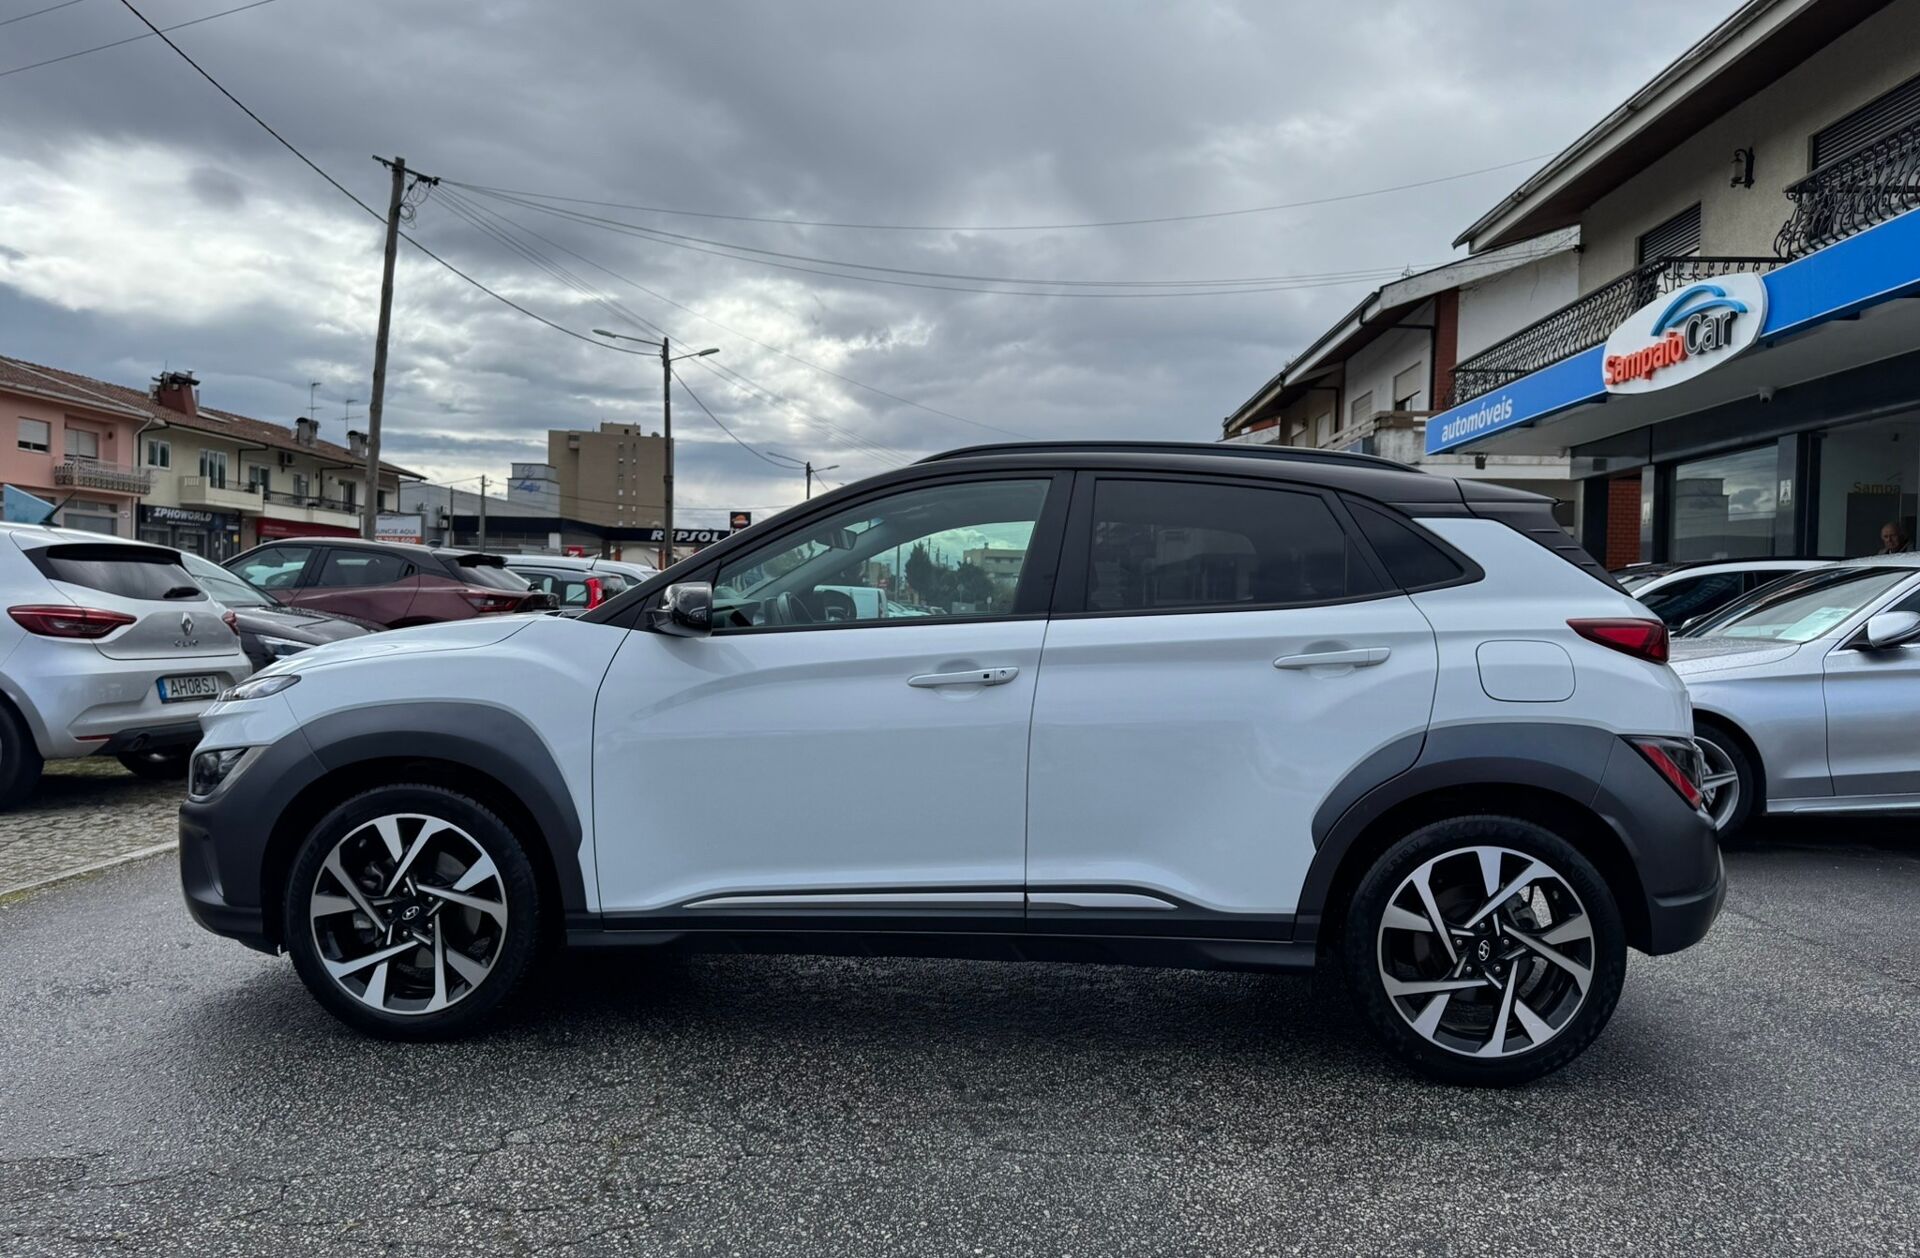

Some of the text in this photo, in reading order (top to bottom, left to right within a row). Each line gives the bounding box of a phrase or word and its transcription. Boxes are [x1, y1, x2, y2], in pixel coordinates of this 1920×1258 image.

[1442, 395, 1513, 442] automóveis
[651, 530, 720, 542] RPSOL
[171, 677, 216, 696] AH08SJ
